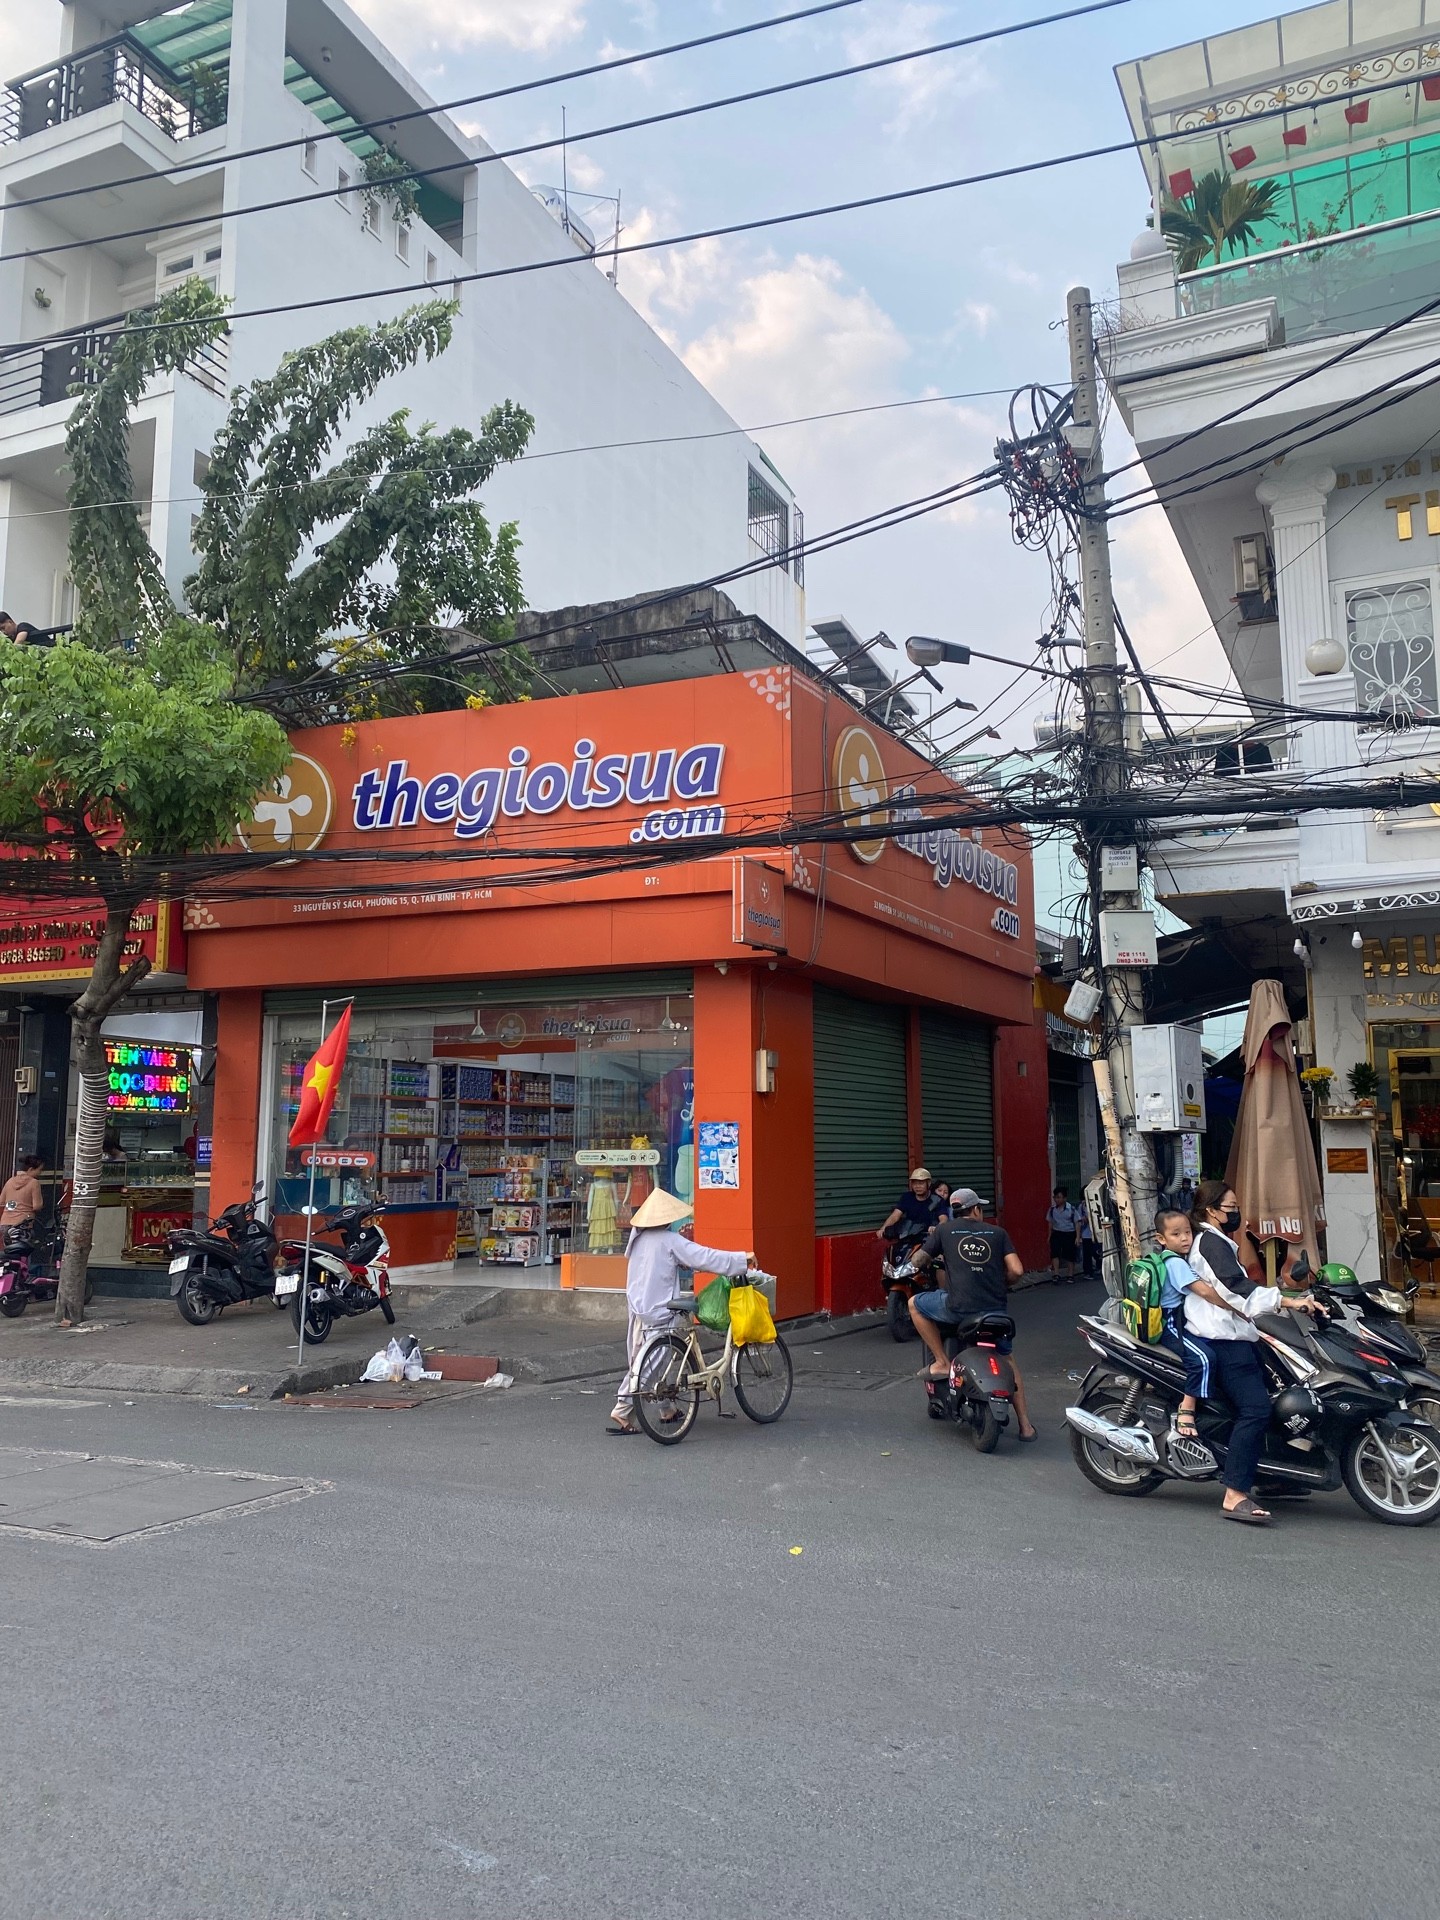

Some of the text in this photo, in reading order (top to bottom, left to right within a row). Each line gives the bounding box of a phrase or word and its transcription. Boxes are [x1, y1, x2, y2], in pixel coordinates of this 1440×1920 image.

[352, 738, 725, 838] thegioisua
[630, 804, 726, 843] .com
[293, 903, 301, 912] 33
[302, 899, 331, 912] NGUYỄN
[343, 898, 364, 909] SÁCH,
[400, 896, 409, 906] 15,
[411, 896, 419, 904] Q.
[462, 891, 472, 900] TP.
[475, 890, 492, 898] HCM
[991, 907, 1020, 939] .com
[74, 1183, 88, 1195] 53
